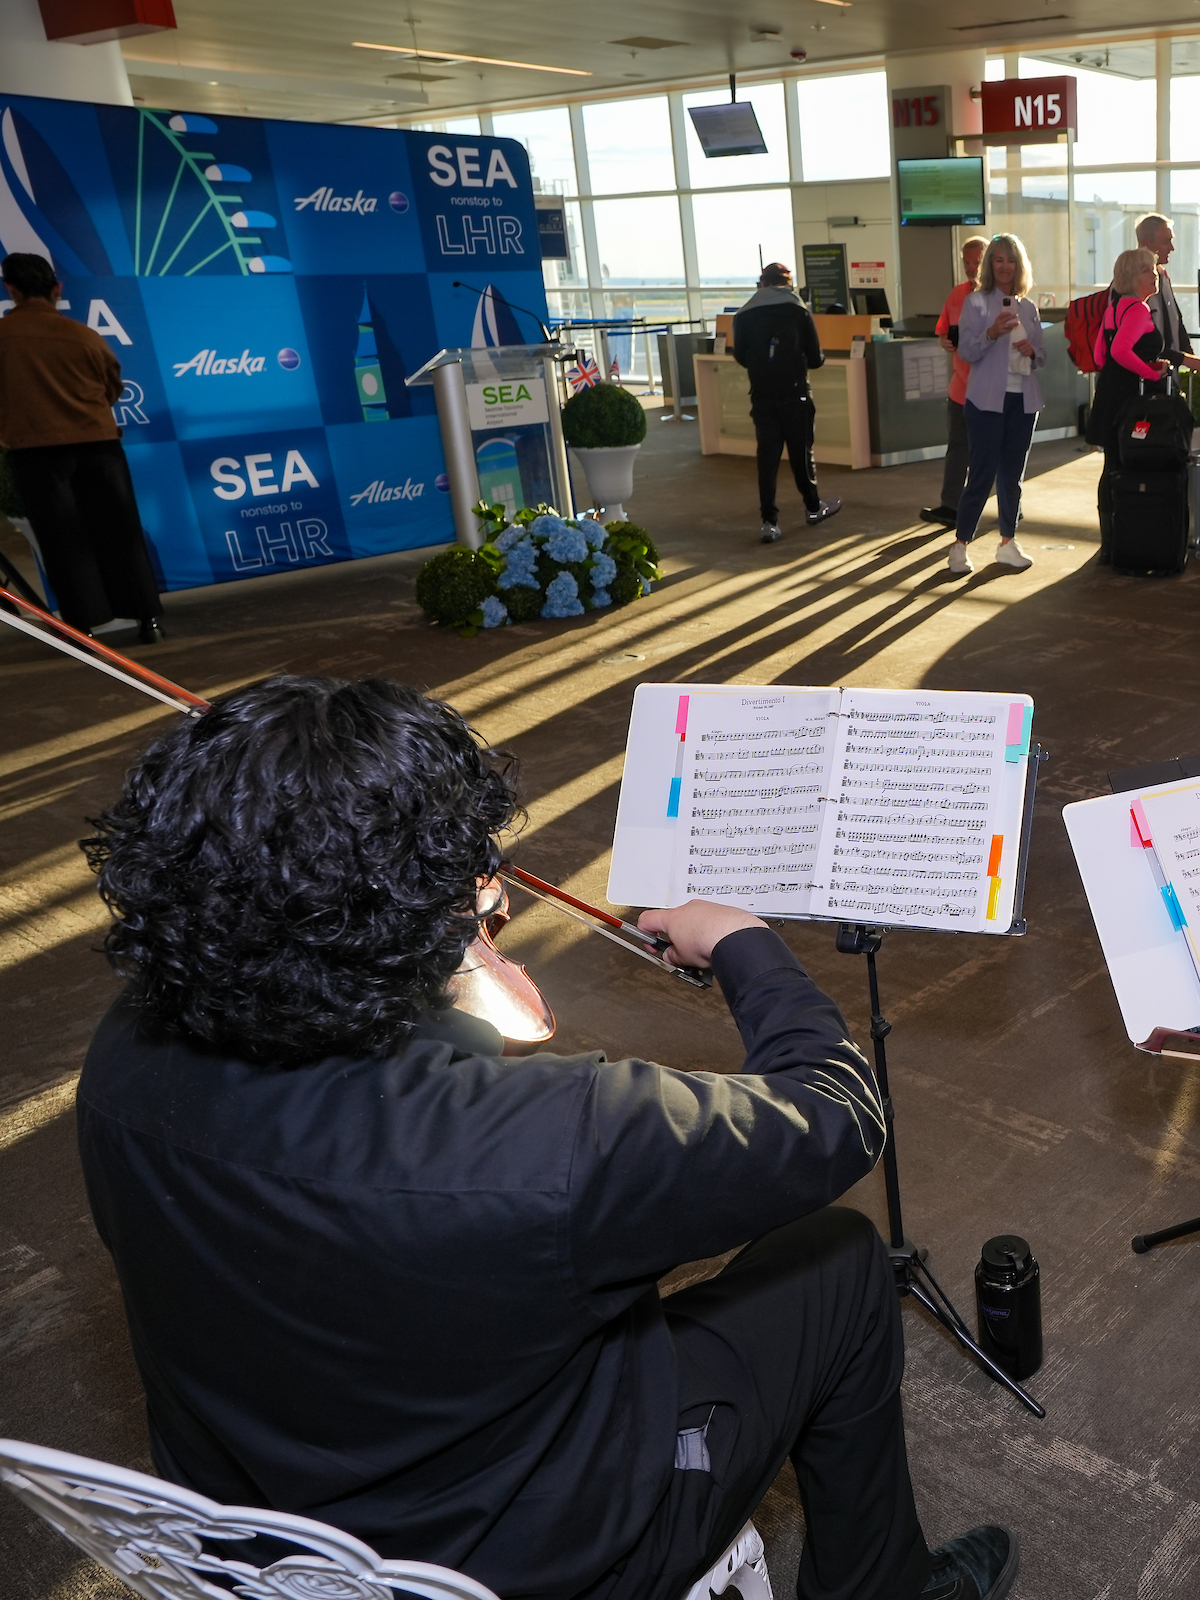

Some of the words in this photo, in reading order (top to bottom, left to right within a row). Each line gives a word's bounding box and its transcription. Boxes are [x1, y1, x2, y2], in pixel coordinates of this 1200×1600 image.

[893, 96, 939, 127] N15
[1014, 93, 1062, 127] N15
[427, 144, 518, 188] SEA
[294, 186, 378, 215] Alaska
[450, 196, 490, 208] nonstop
[492, 196, 503, 207] to
[436, 215, 525, 255] LHR
[172, 349, 266, 377] Alaska
[482, 384, 532, 405] SEA
[485, 411, 517, 419] International
[210, 449, 320, 501] SEA
[349, 477, 425, 507] Alaska
[240, 503, 288, 519] nonstop
[290, 501, 303, 511] to
[225, 517, 334, 572] LHR
[741, 697, 781, 706] Divertimento
